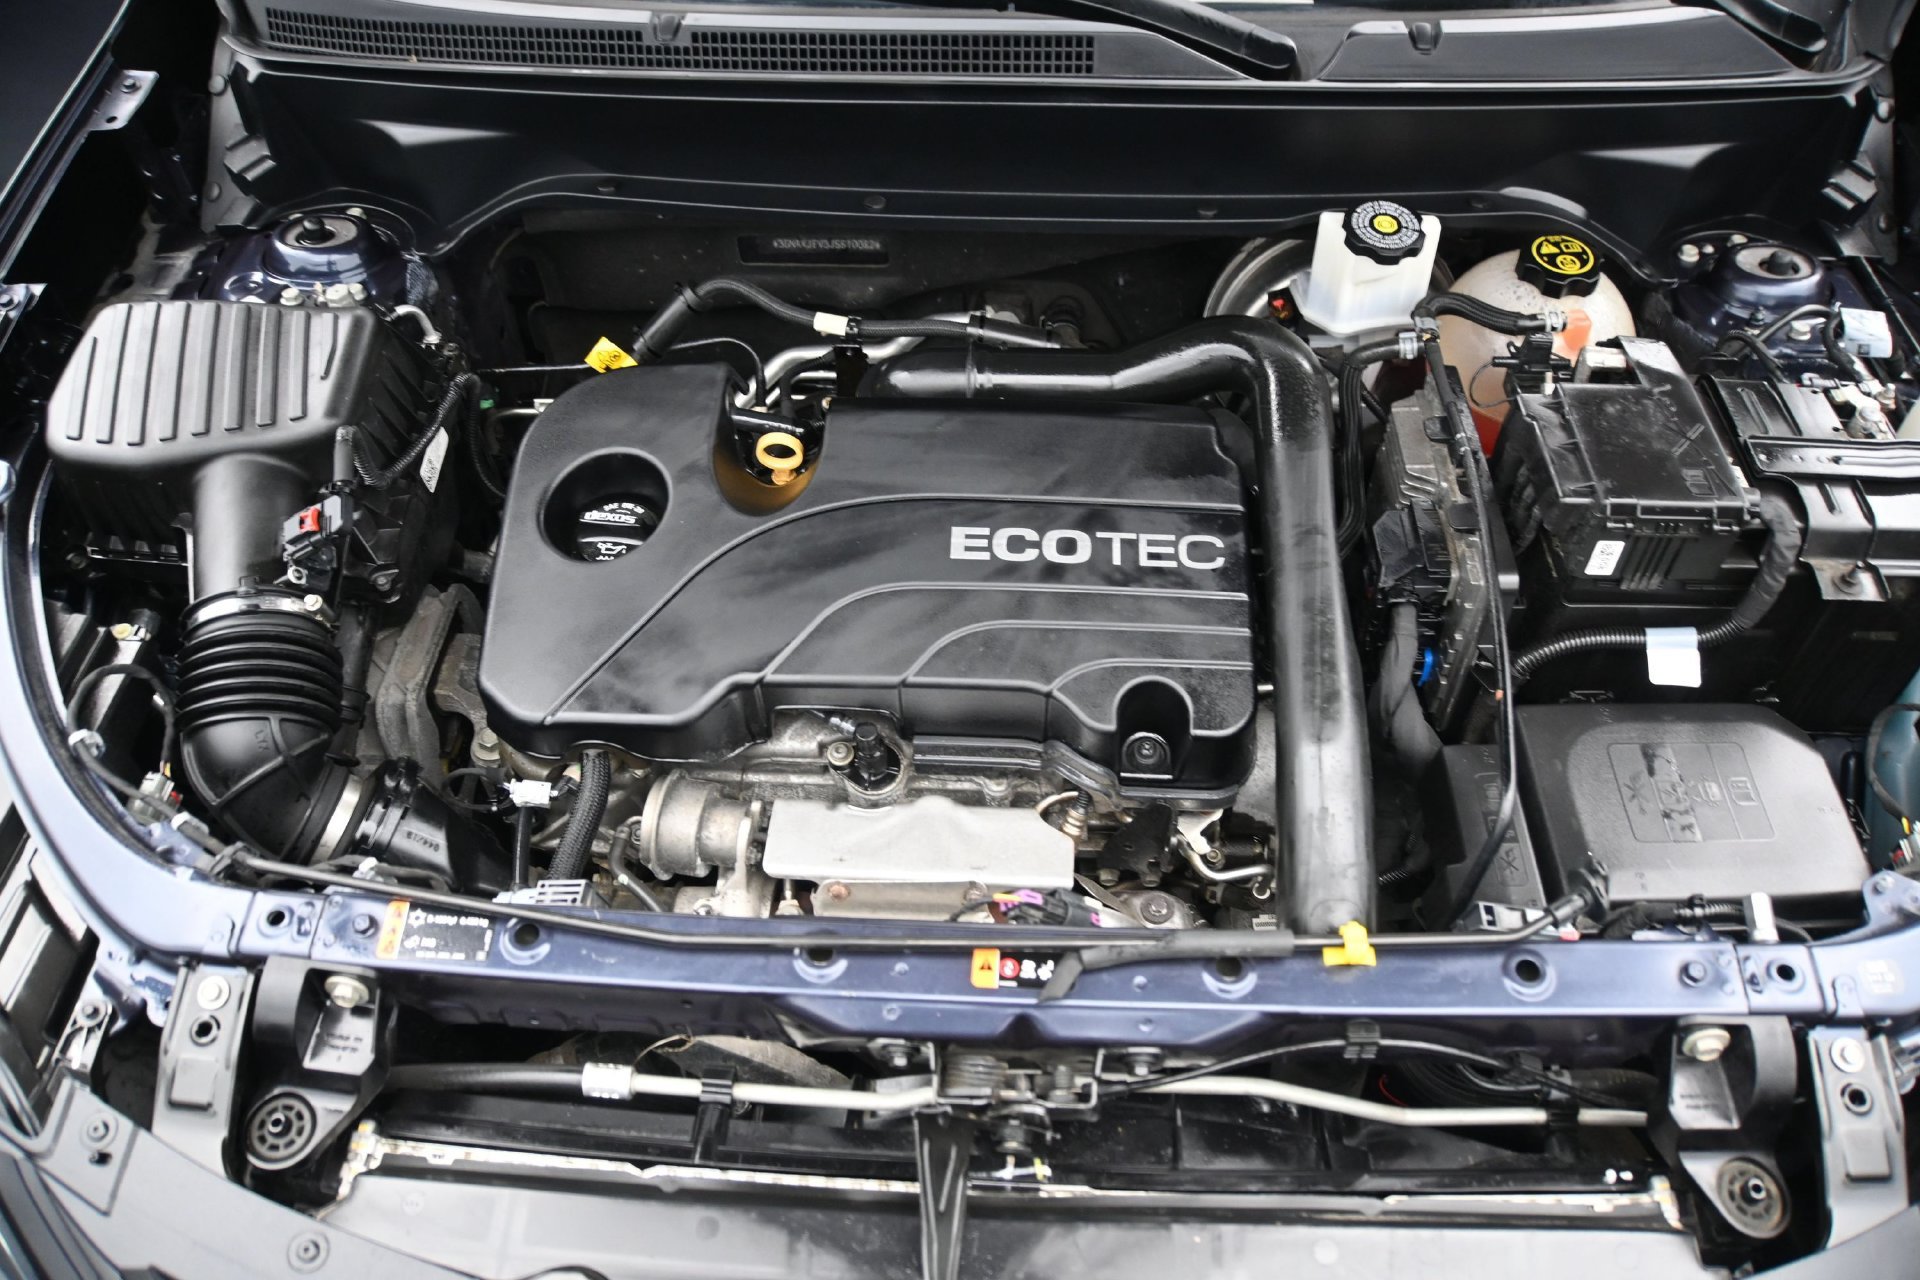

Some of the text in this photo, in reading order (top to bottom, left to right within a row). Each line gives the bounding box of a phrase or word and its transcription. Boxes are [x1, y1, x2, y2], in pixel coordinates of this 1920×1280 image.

[603, 502, 619, 511] SAE
[584, 510, 637, 524] dexos
[949, 526, 1226, 570] ECOTEC
